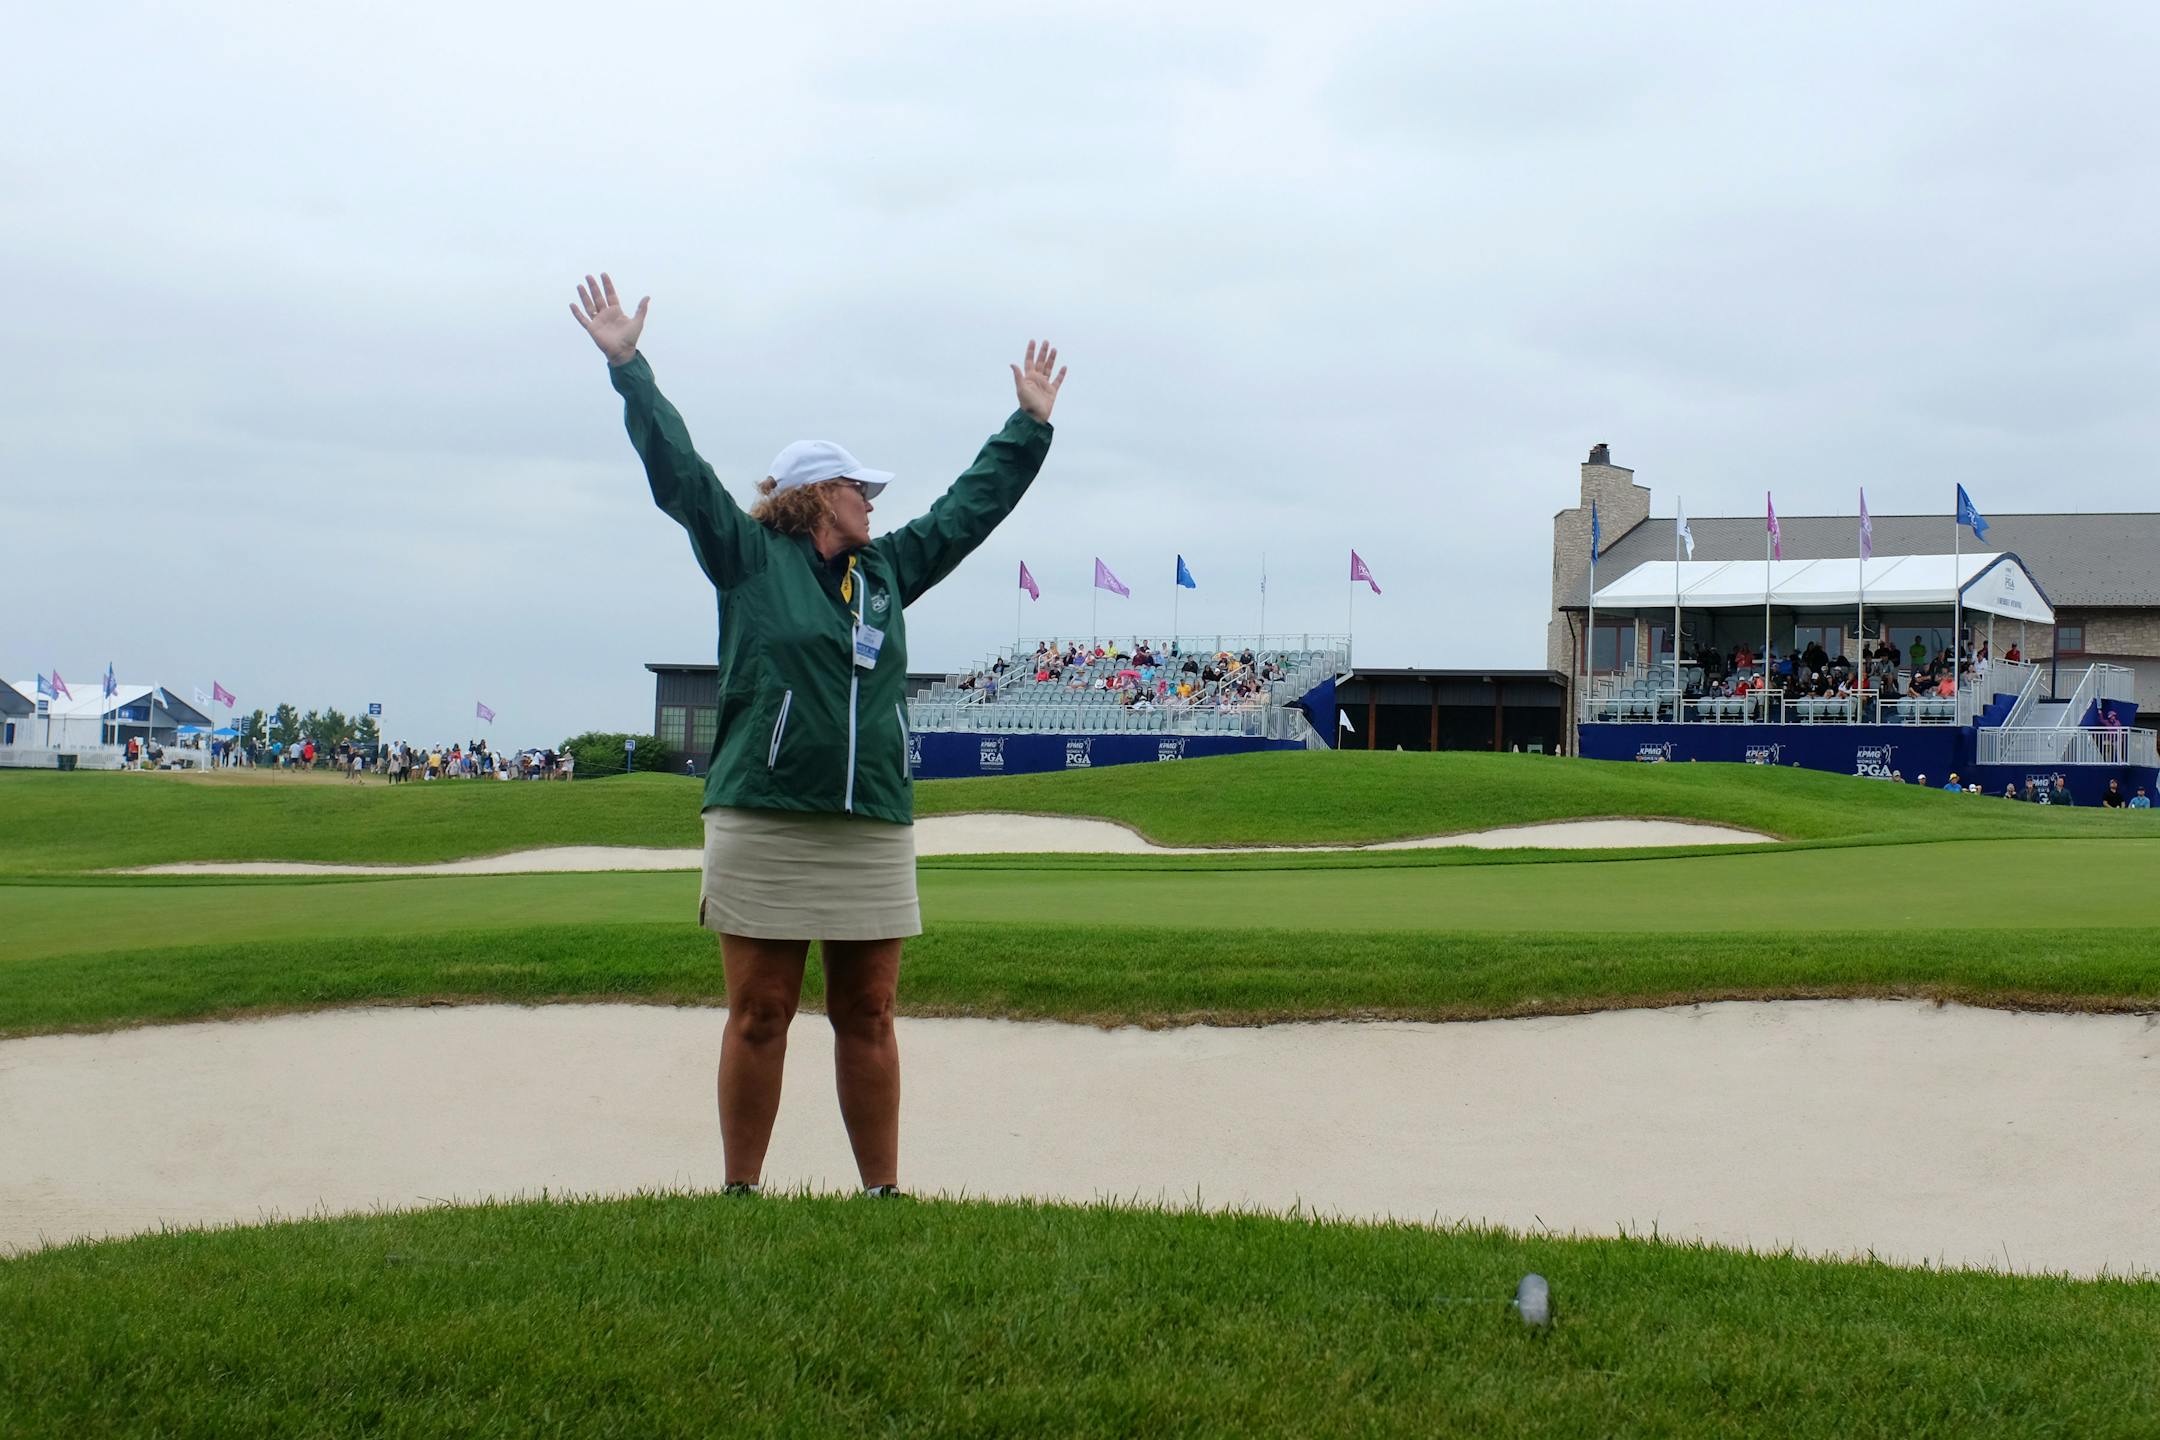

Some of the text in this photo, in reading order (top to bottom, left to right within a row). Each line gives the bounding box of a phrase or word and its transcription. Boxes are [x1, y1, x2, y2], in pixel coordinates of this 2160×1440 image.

[980, 752, 1004, 762] PGA
[1066, 753, 1091, 763] PGA
[1856, 764, 1892, 777] PGA
